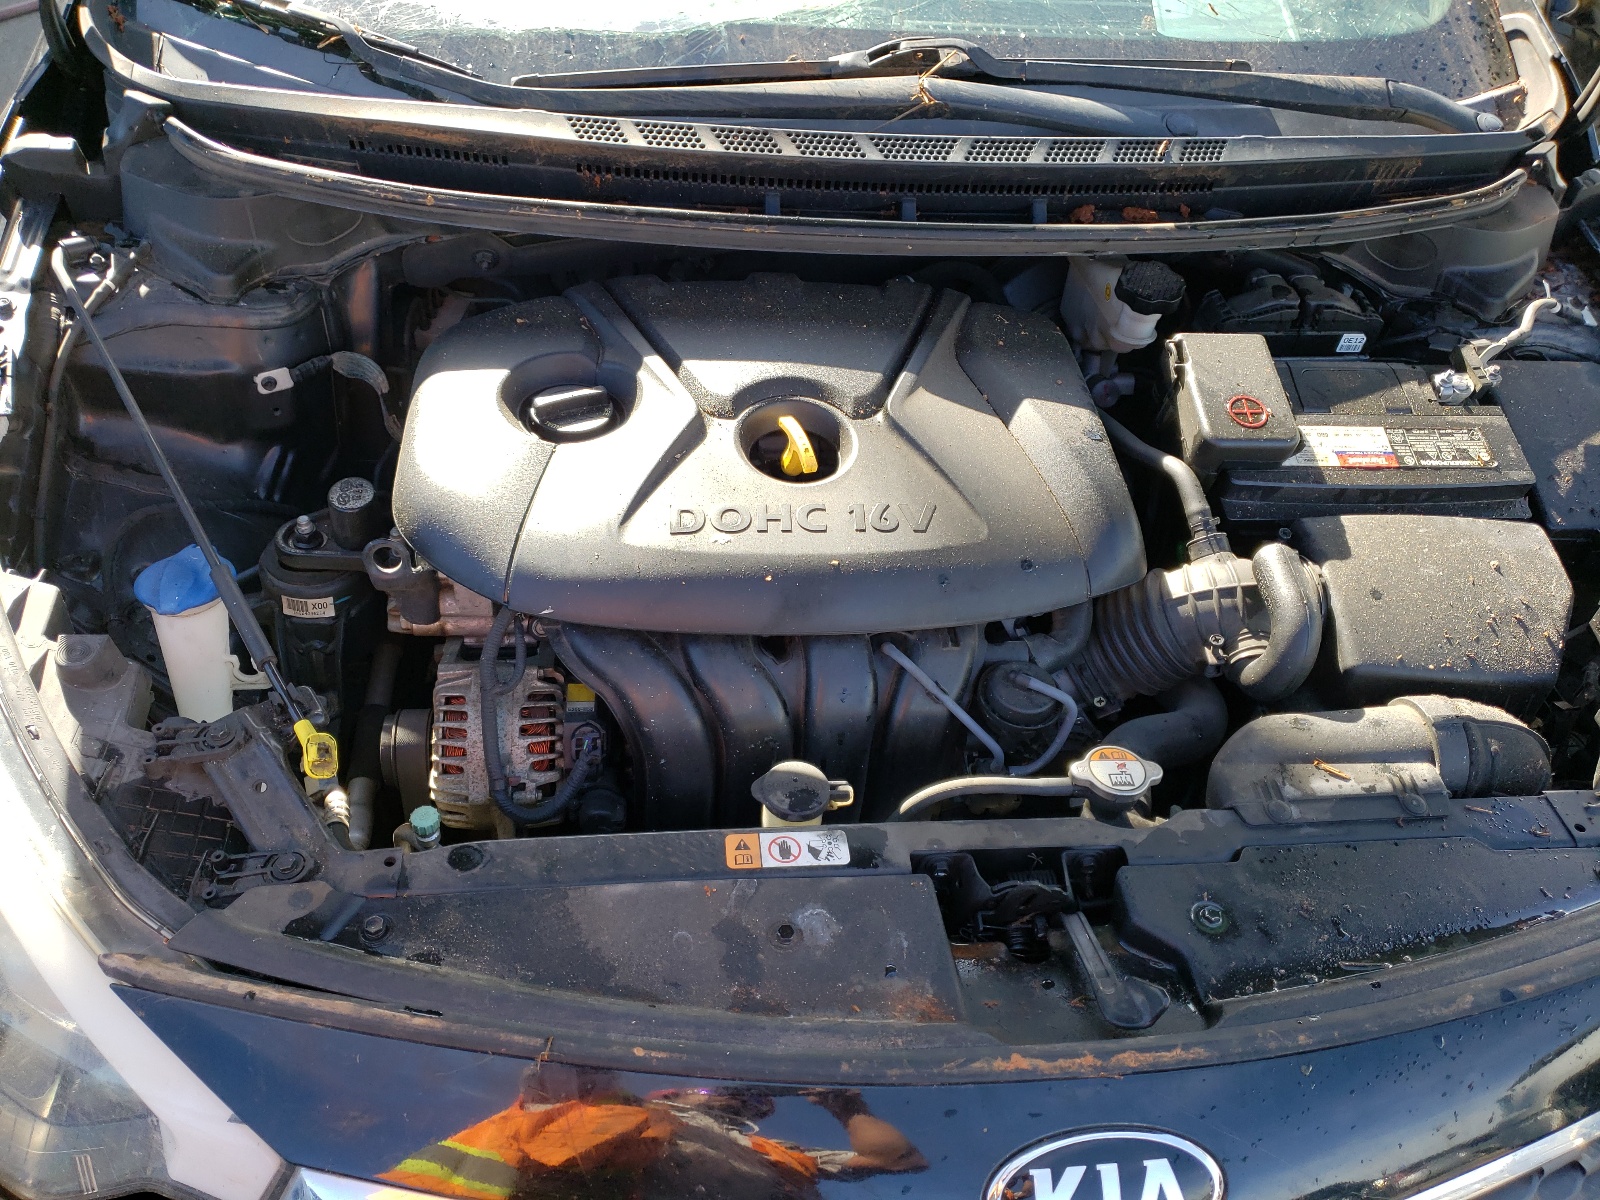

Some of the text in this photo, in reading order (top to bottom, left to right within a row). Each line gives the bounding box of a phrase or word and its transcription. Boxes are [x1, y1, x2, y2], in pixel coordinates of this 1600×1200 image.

[669, 503, 937, 535] DOHC 16V
[1029, 1157, 1185, 1200] KIA
